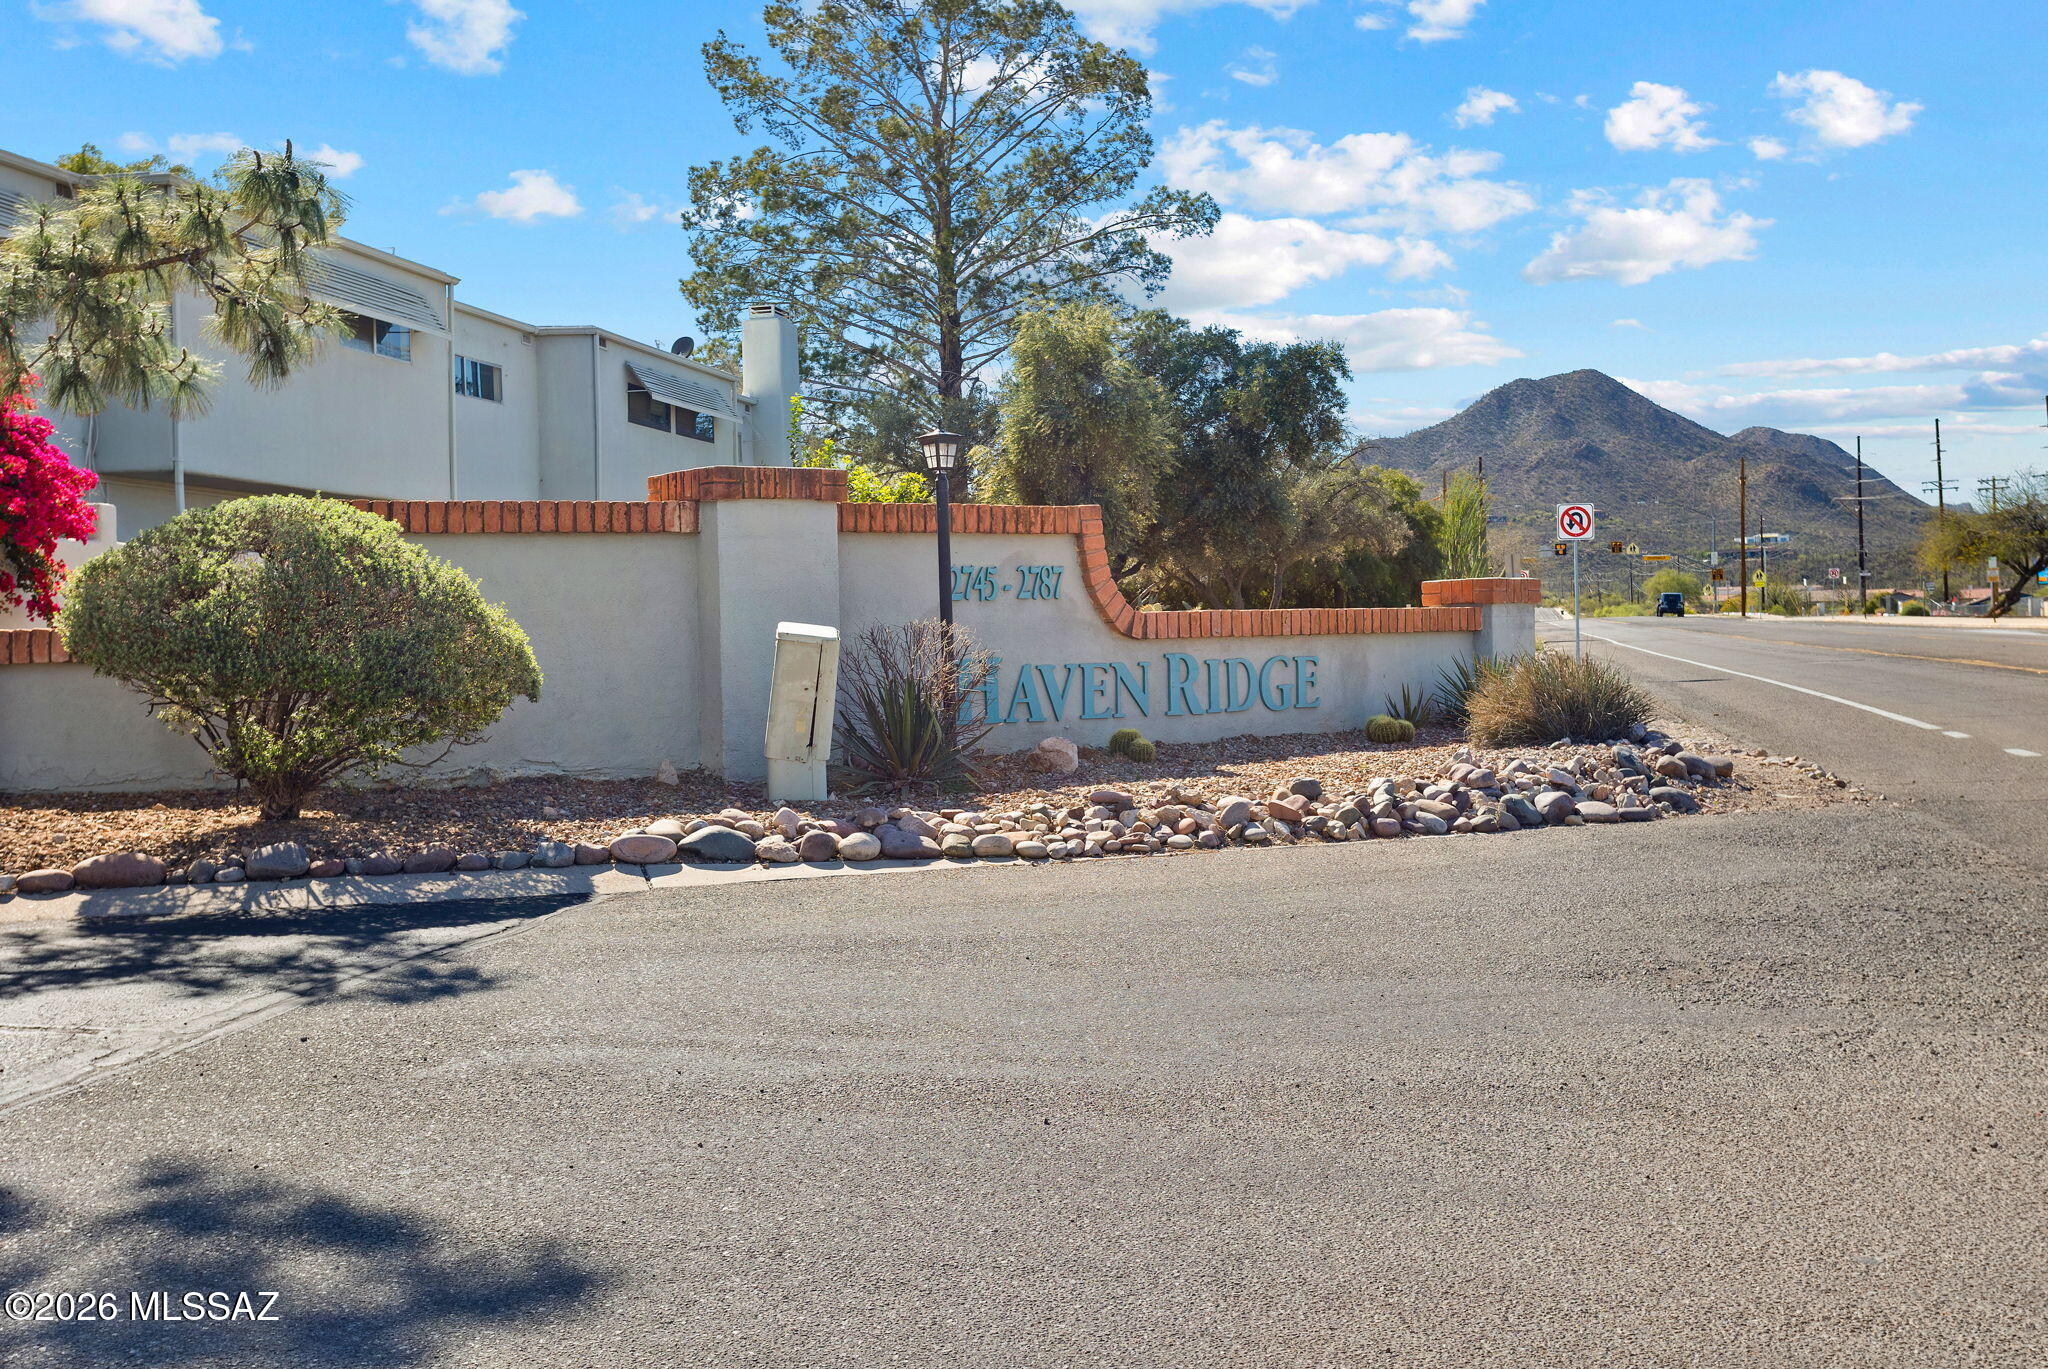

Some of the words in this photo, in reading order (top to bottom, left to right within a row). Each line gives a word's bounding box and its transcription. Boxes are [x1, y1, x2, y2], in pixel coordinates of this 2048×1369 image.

[951, 565, 998, 601] 2745
[1016, 564, 1065, 600] 2787
[957, 656, 1150, 726] HAVEN
[1164, 653, 1321, 717] RIDGE
